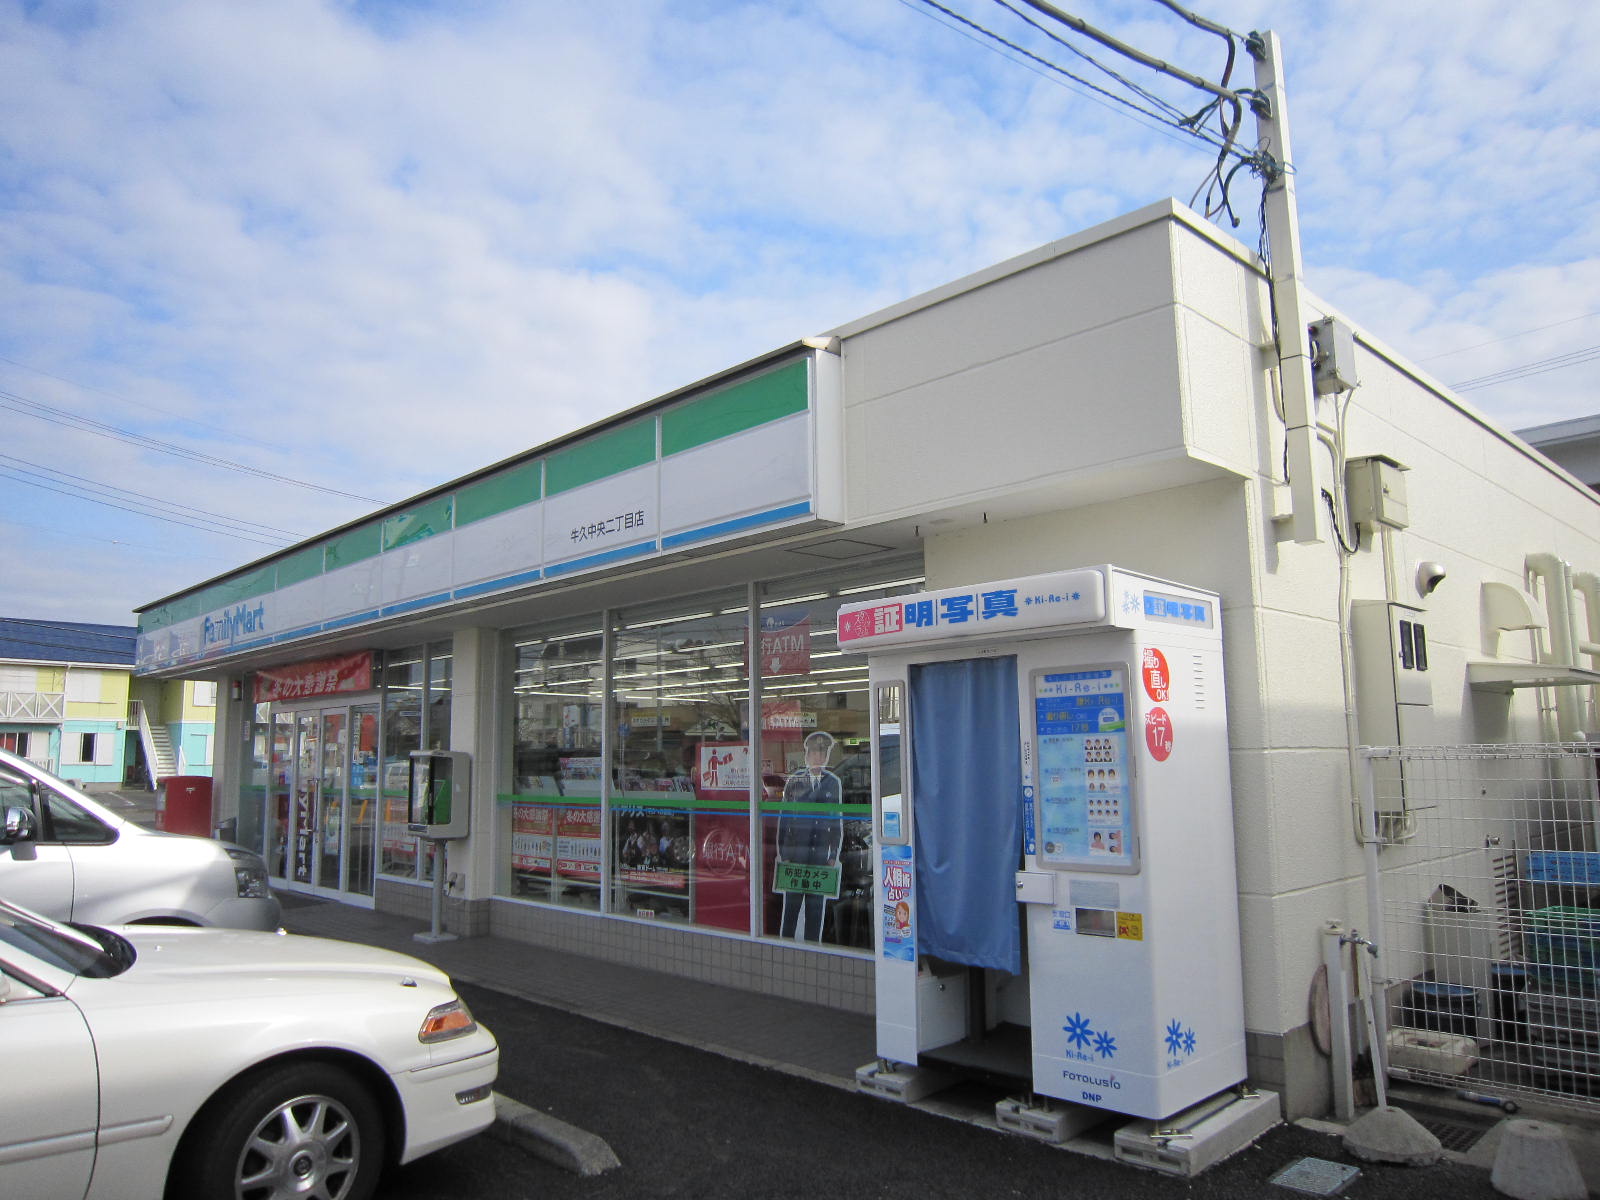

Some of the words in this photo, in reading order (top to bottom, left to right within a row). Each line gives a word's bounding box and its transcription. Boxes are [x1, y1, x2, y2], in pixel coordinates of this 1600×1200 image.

[570, 510, 645, 542] 牛久中央二丁目店
[874, 589, 1018, 634] 証明写真
[204, 600, 265, 647] FamilyMart
[761, 634, 804, 656] 行ATM
[1145, 713, 1167, 725] スピード
[1153, 727, 1165, 747] 17
[784, 867, 829, 880] 防犯カメラ
[790, 878, 822, 890] 作動中
[1082, 1091, 1102, 1103] DNP
